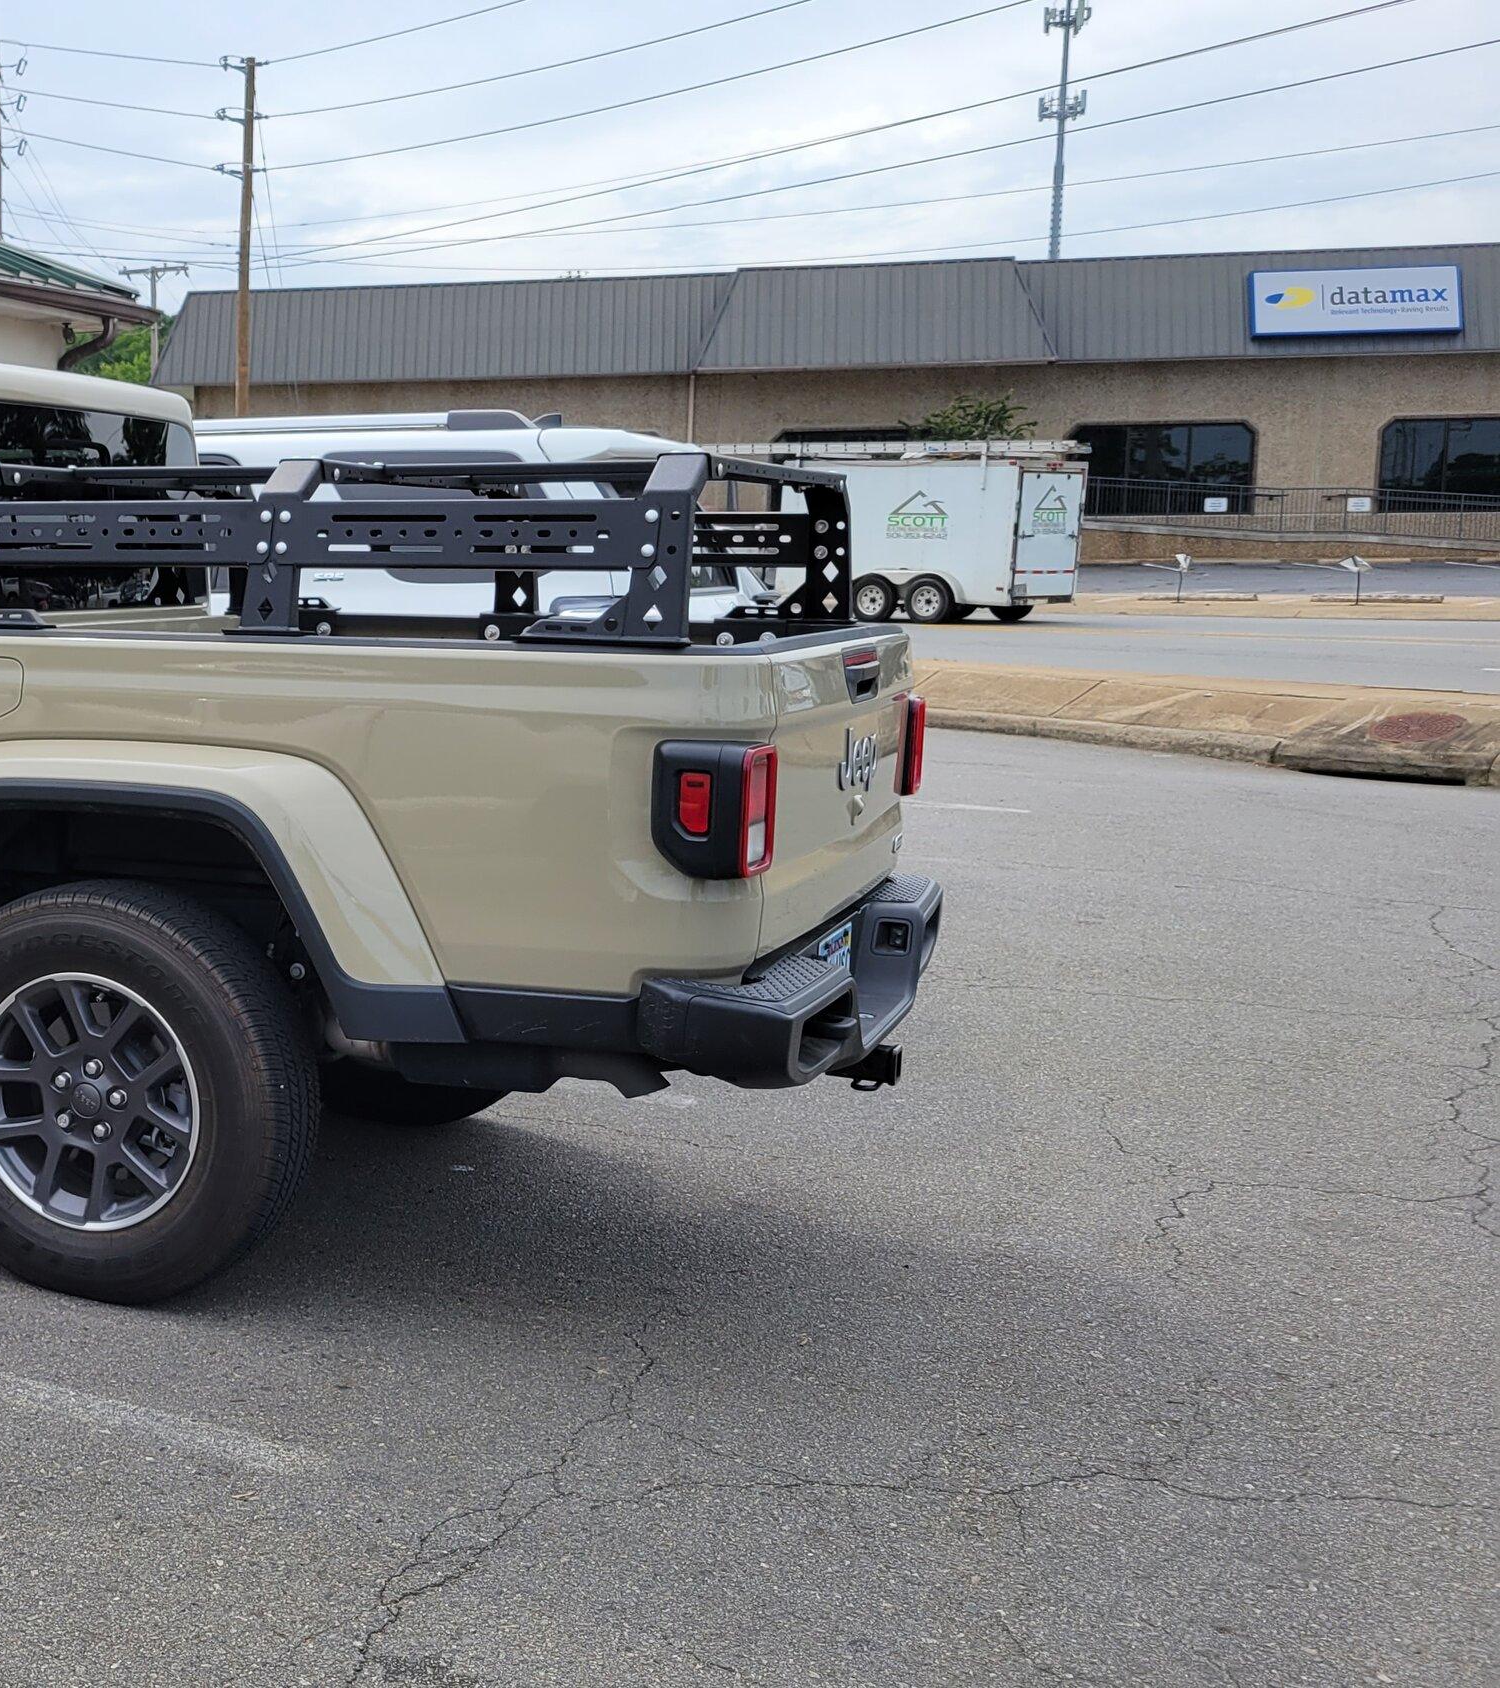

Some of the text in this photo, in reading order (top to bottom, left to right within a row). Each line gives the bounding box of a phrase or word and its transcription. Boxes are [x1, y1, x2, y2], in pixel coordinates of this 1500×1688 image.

[1330, 286, 1448, 306] datamax
[887, 515, 948, 527] SCOTT
[1032, 511, 1067, 522] SCOTT
[837, 726, 877, 792] Jeep
